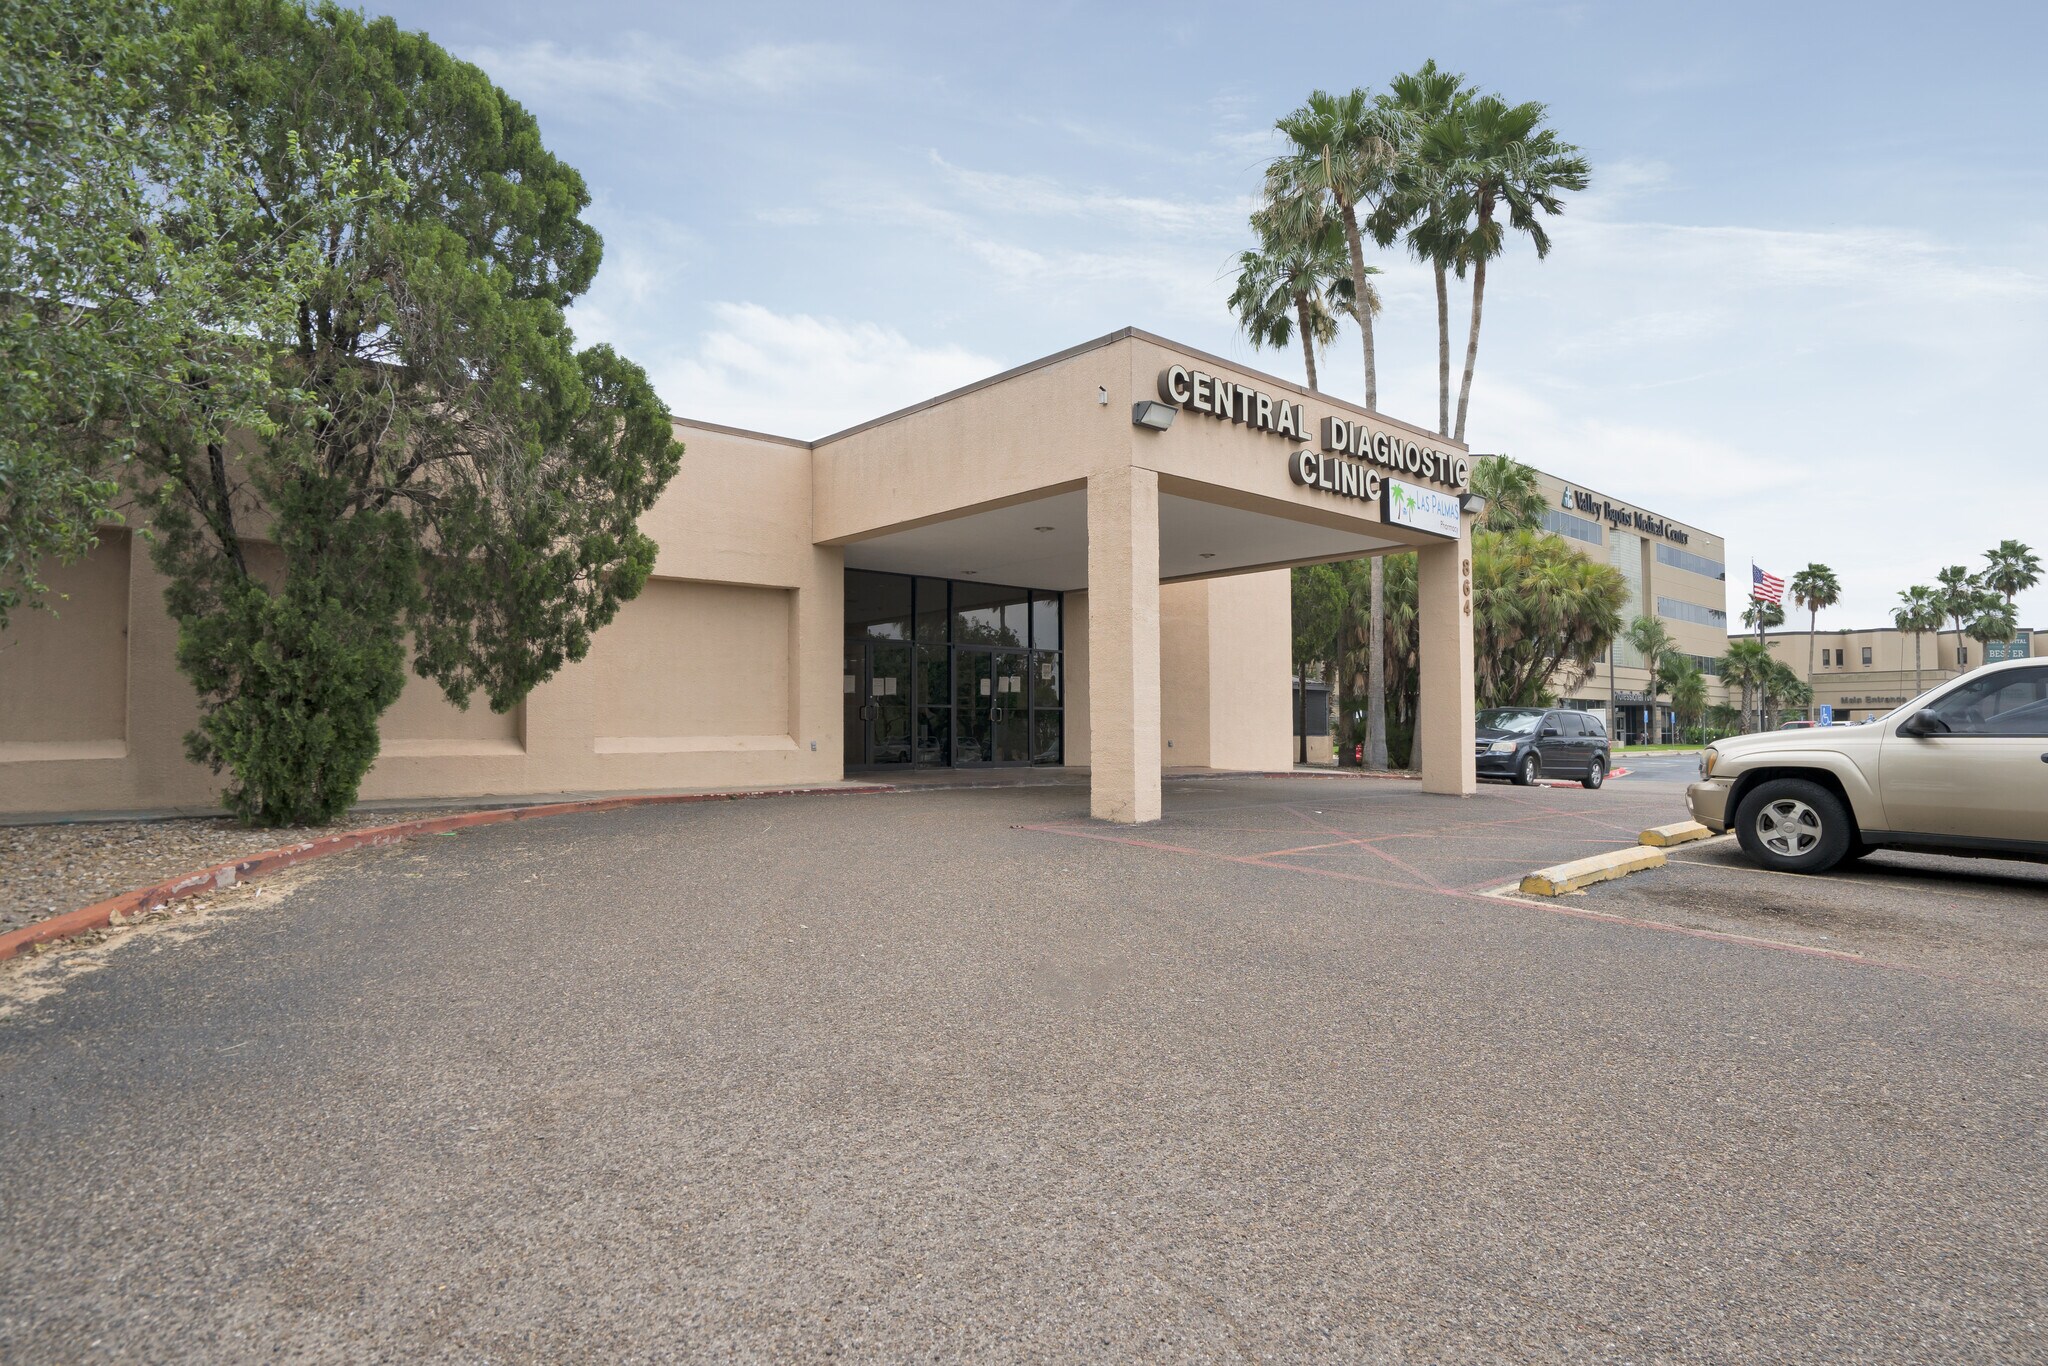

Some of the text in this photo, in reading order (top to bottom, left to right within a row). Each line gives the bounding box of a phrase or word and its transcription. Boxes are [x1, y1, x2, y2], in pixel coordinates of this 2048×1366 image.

[1160, 364, 1469, 488] CENTRAL DIAGNOSTIC
[1291, 449, 1381, 501] CLINIC
[1416, 490, 1459, 520] LAS PALMAS
[1574, 490, 1690, 545] Valley Baptist Medical Center
[1462, 558, 1471, 617] 864
[1841, 695, 1907, 705] Main Entrance
